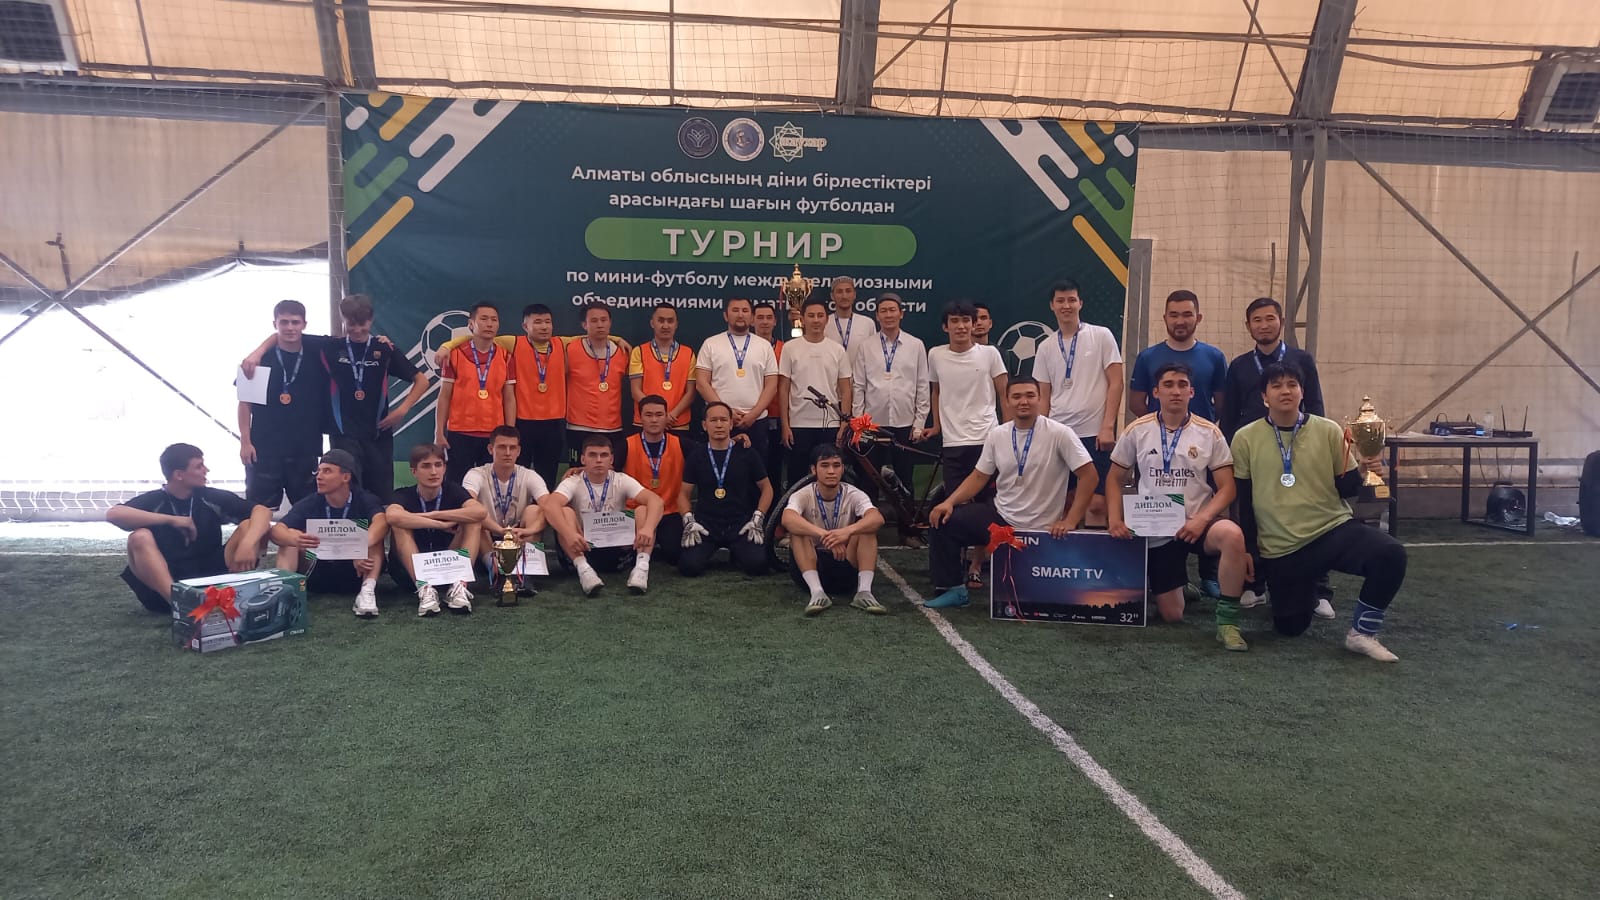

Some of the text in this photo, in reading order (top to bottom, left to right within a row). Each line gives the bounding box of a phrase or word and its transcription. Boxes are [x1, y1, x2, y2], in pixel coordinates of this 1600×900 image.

[571, 166, 931, 193] Алматы облысының діни бірлестіктері
[609, 194, 895, 214] арасындағы шағын футболдан
[662, 228, 843, 259] ТУРНИР
[566, 271, 589, 282] по
[594, 270, 728, 289] мини-футболу
[734, 275, 784, 289] межд
[855, 298, 927, 312] обсти
[1149, 466, 1196, 478] Emrates
[593, 516, 626, 525] ДИПЛОМ
[423, 555, 461, 566] ДИПЛОМ
[1031, 566, 1103, 579] SMART TV
